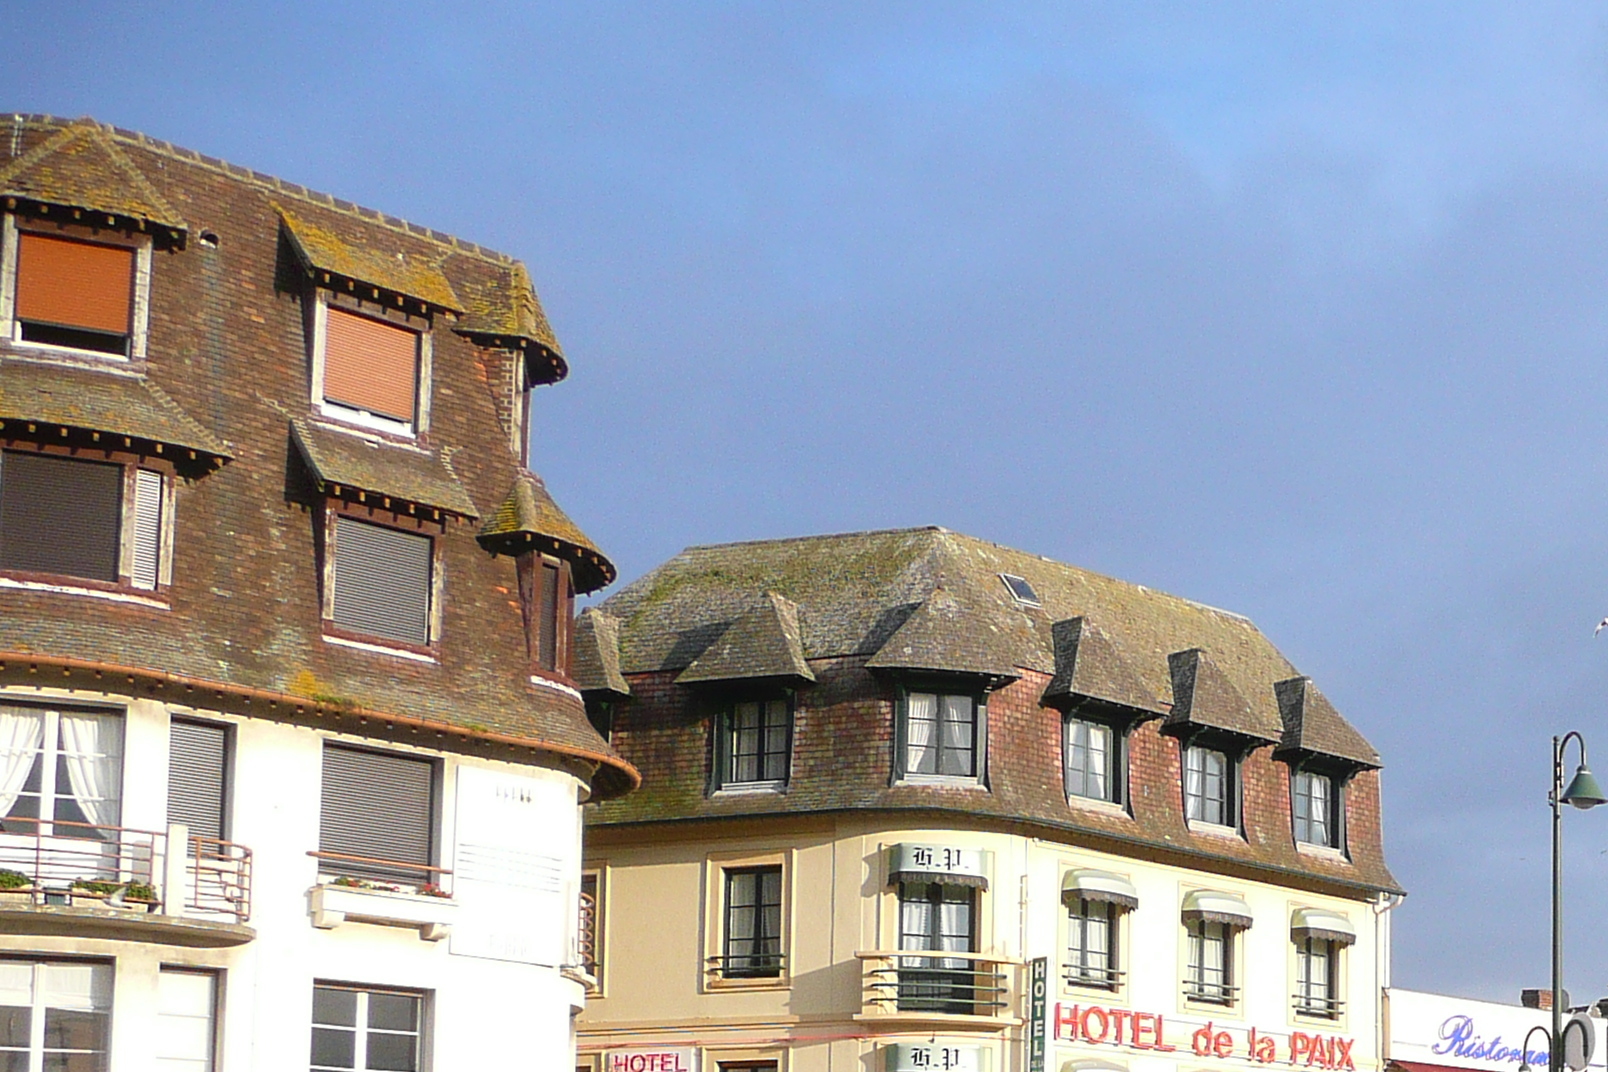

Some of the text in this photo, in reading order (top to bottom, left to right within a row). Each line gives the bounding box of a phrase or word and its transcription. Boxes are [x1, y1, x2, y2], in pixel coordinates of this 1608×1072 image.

[1033, 961, 1045, 1056] HOTEL
[1054, 1002, 1356, 1071] HOTEL de la PAIX
[1432, 1015, 1566, 1067] Ristoran
